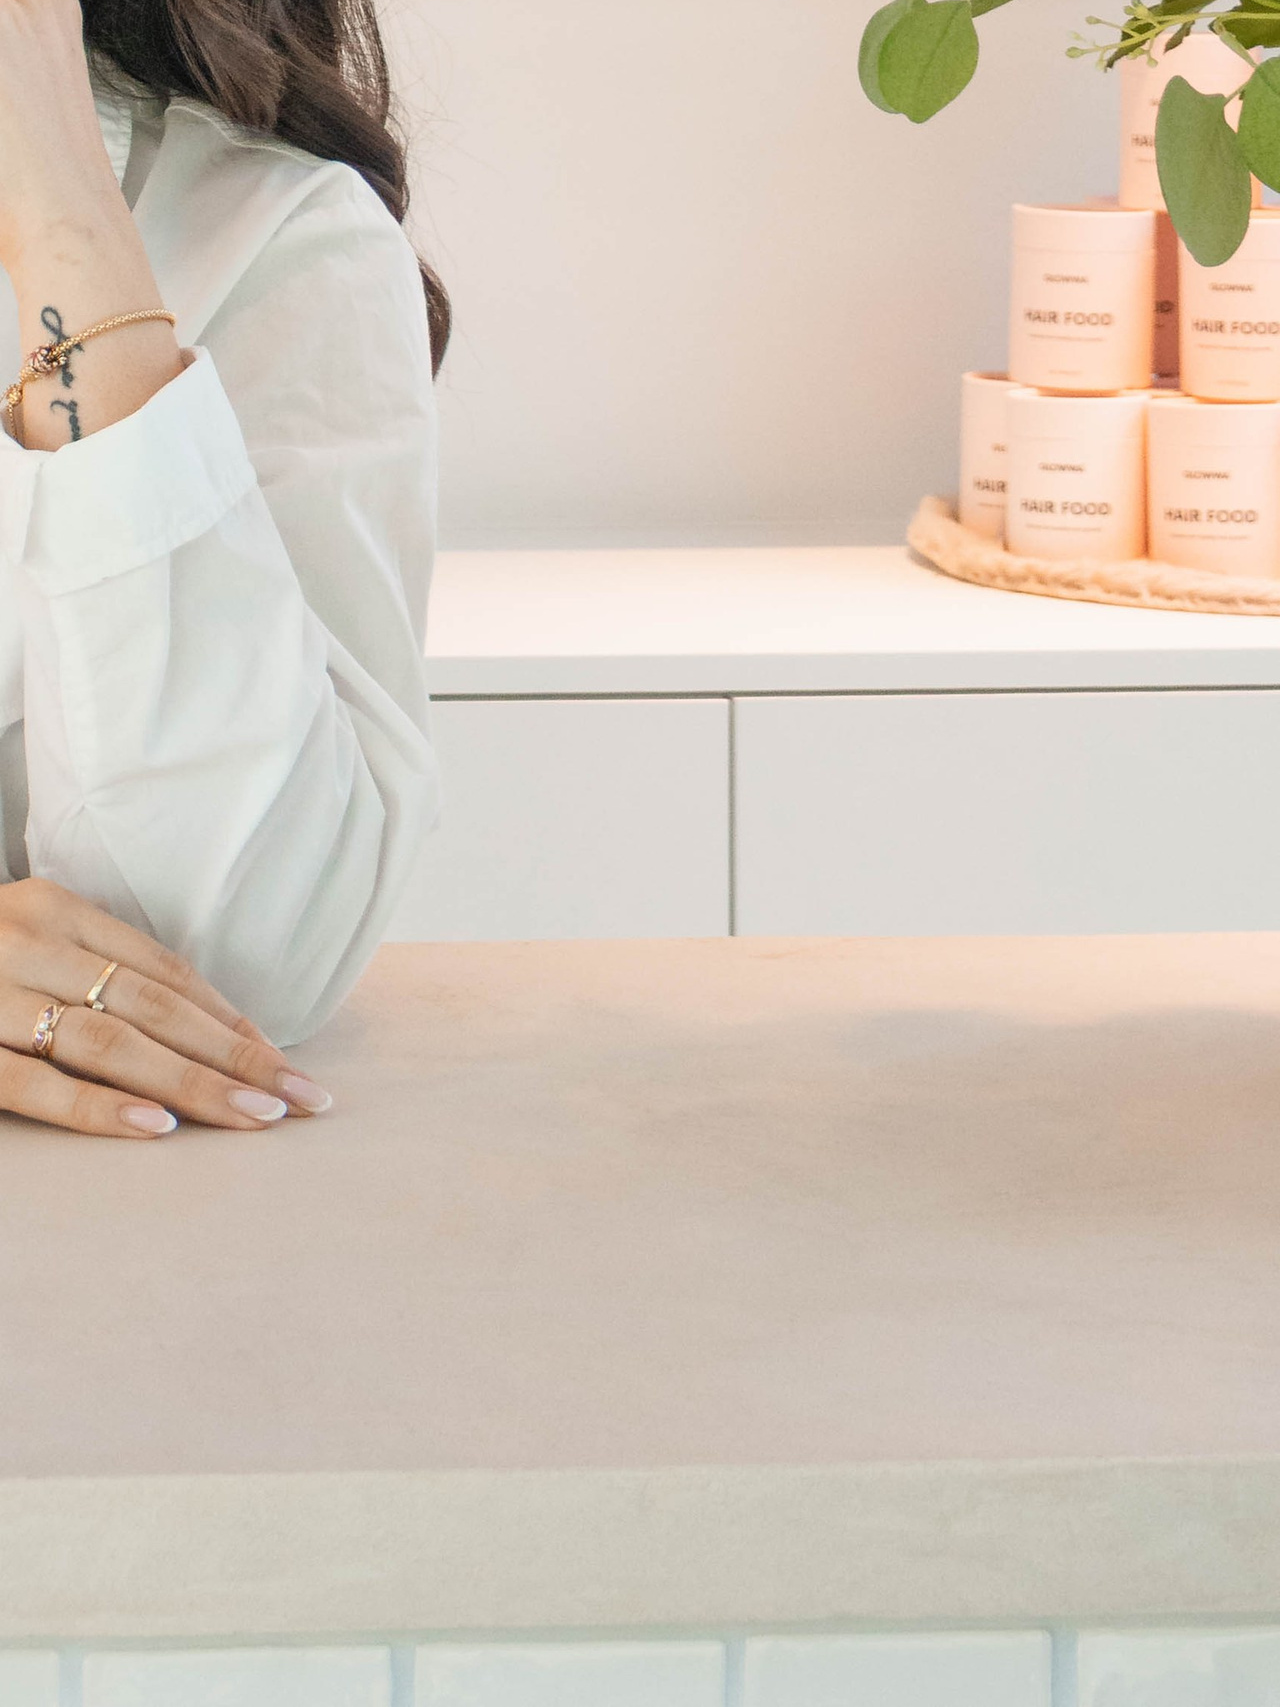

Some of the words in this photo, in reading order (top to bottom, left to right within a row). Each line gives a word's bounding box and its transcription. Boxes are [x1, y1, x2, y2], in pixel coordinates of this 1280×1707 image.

[1023, 308, 1059, 324] HAIR
[1063, 311, 1113, 327] FOOD
[1191, 319, 1226, 334] HAIR
[973, 476, 1008, 493] HAIR
[1019, 498, 1056, 515] HAIR
[1060, 500, 1112, 516] FOOD
[1163, 507, 1202, 523] HAIR
[1205, 508, 1260, 524] FOOD
